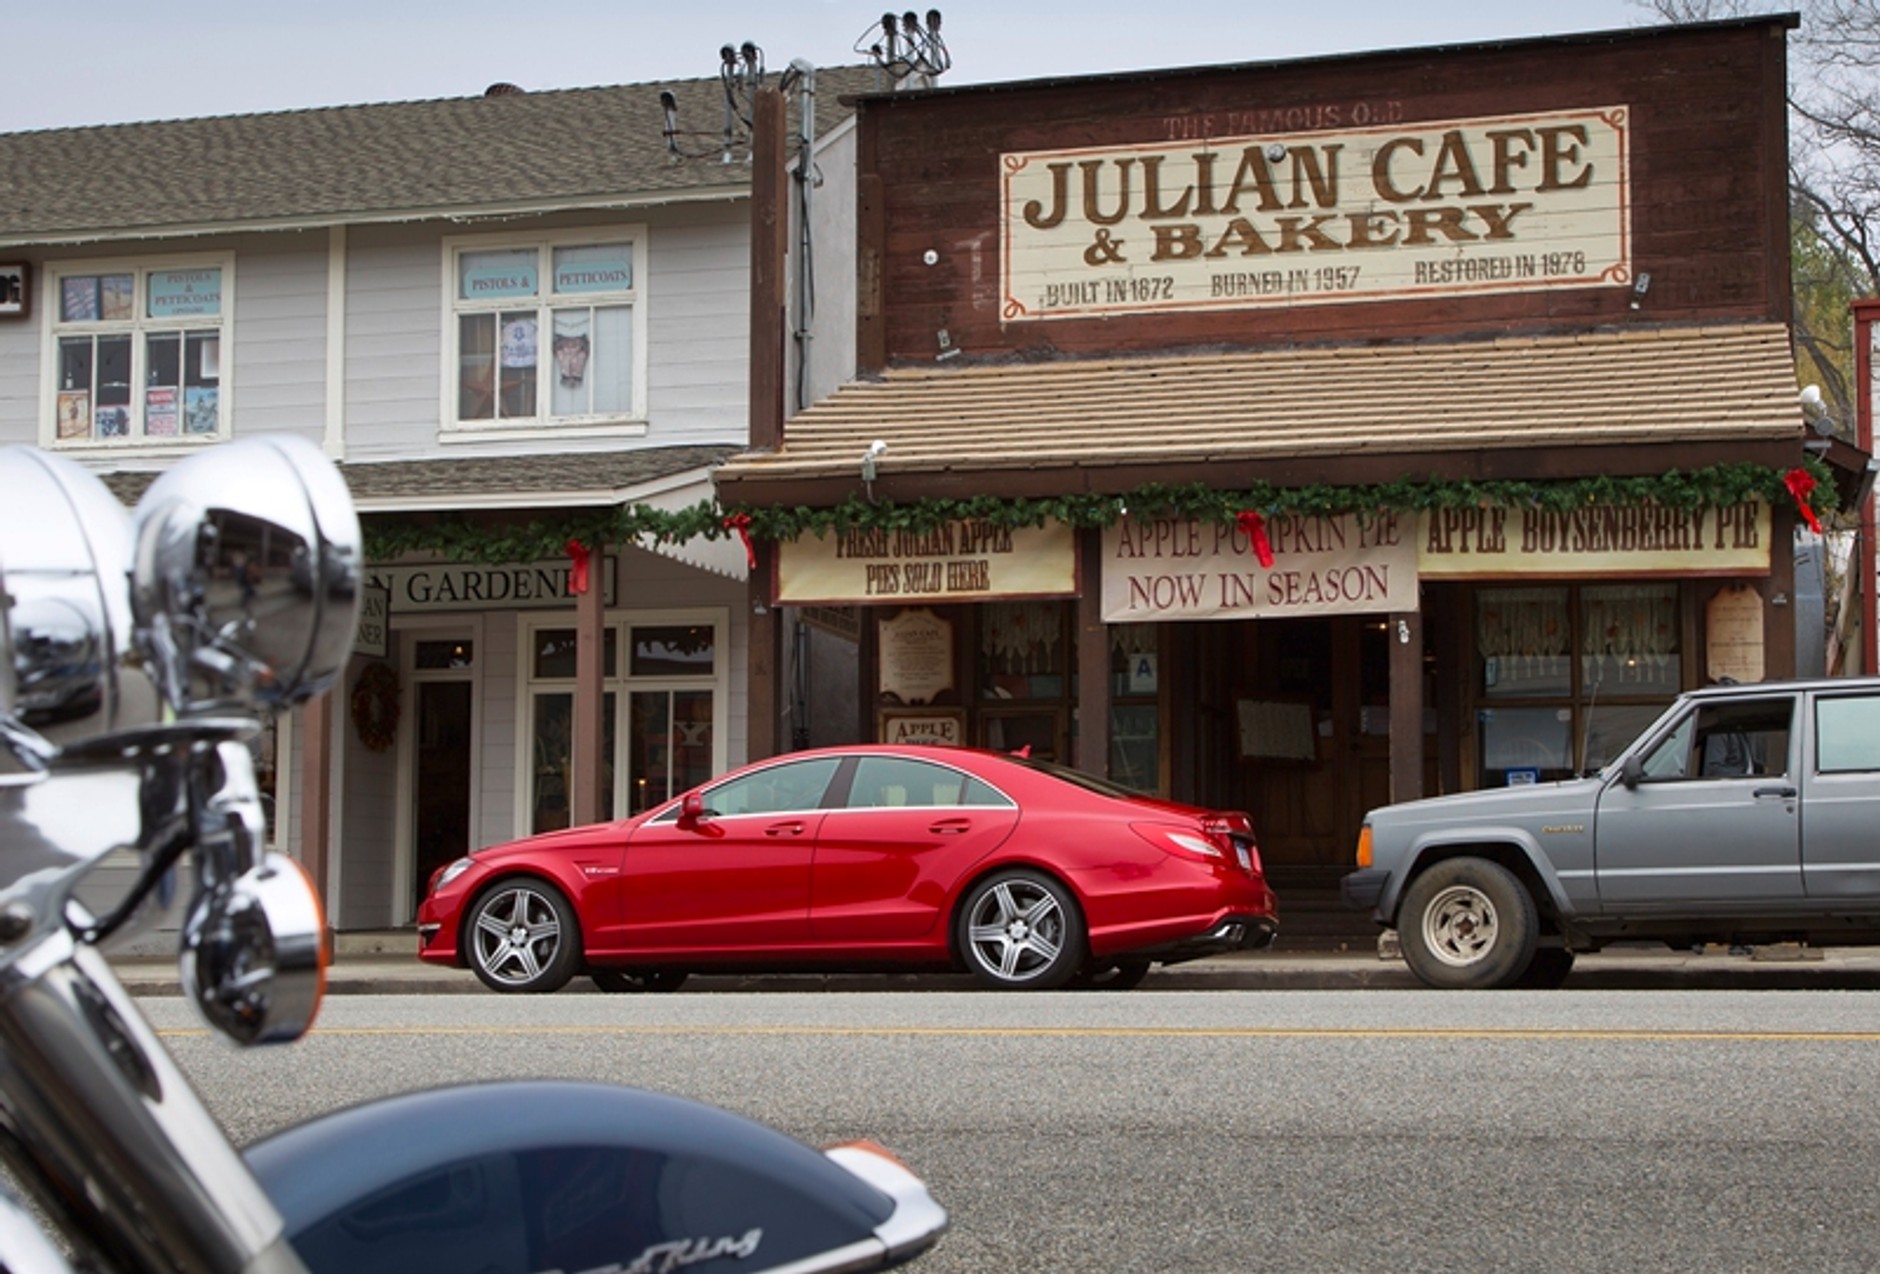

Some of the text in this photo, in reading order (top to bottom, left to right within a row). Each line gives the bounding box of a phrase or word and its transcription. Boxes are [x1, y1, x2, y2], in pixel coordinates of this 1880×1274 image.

[1163, 100, 1404, 140] THE FAMOUS OLD
[1023, 124, 1594, 229] JULIAN CAFE
[1084, 202, 1534, 266] & BAKERY
[472, 274, 530, 291] PISTOLS &
[559, 269, 628, 286] PETTICOATS
[1211, 265, 1361, 297] BURNED IN 1957
[1414, 250, 1586, 284] RESTORED IN 1978
[1046, 280, 1100, 307] BUILT
[1106, 279, 1127, 303] IN
[959, 519, 1014, 555] APPLE
[1116, 517, 1203, 559] APPLE
[1357, 507, 1400, 550] PIE
[1427, 500, 1759, 553] APPLE BOYSENBERRY PIE
[406, 568, 579, 603] GARDEN
[865, 559, 991, 595] PIES SOLD HERE
[1129, 564, 1390, 610] NOW IN SEASON
[1136, 656, 1154, 678] A
[896, 720, 956, 745] APPLE
